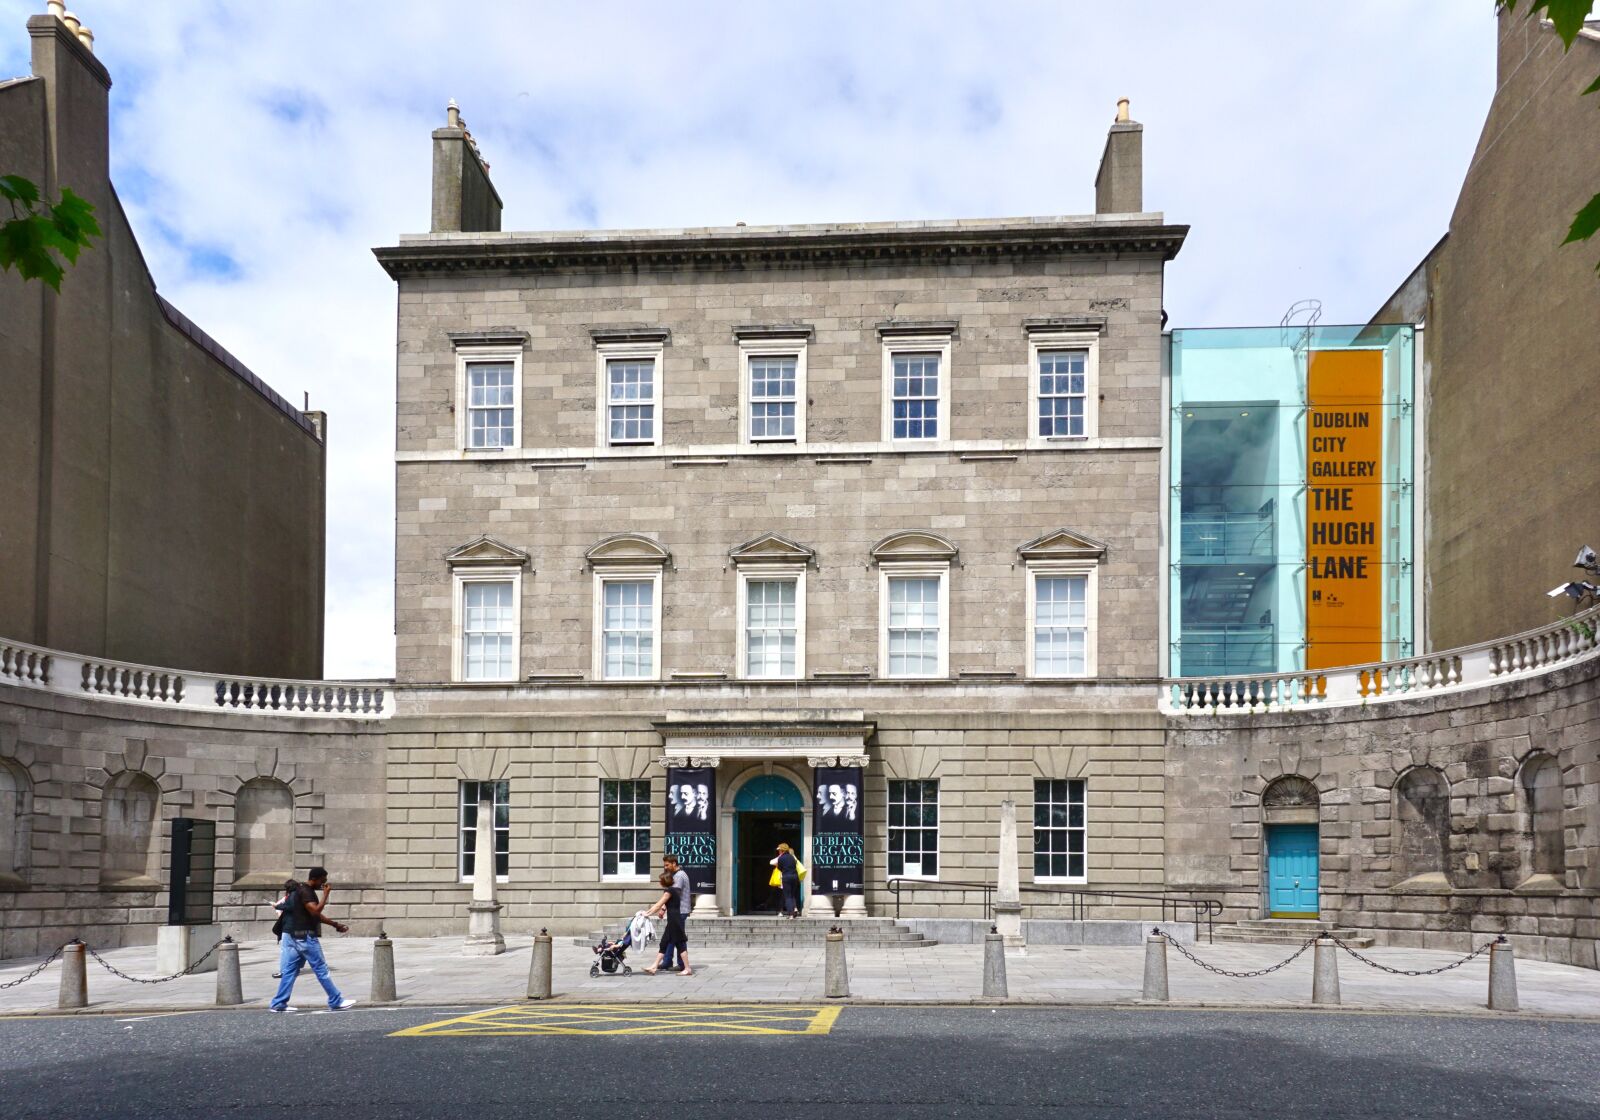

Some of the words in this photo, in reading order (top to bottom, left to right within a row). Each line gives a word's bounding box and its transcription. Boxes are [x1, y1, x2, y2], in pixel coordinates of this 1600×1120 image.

[1313, 412, 1369, 428] DUBLIN
[1312, 436, 1347, 453] CITY
[1312, 461, 1376, 477] GALLERY
[1312, 488, 1353, 511] THE
[1312, 522, 1375, 545] HUGH
[1312, 556, 1368, 579] LANE
[704, 737, 742, 747] DUBLIN
[749, 737, 774, 747] CITY
[780, 737, 825, 747] GALLERY
[664, 836, 716, 846] DUBLIN'S
[812, 836, 864, 846] DUBLIN'S
[664, 845, 715, 856] LEGACY
[812, 845, 863, 856] LEGACY
[688, 855, 716, 864] LOSS
[812, 855, 834, 865] AND
[837, 855, 864, 865] LOSS
